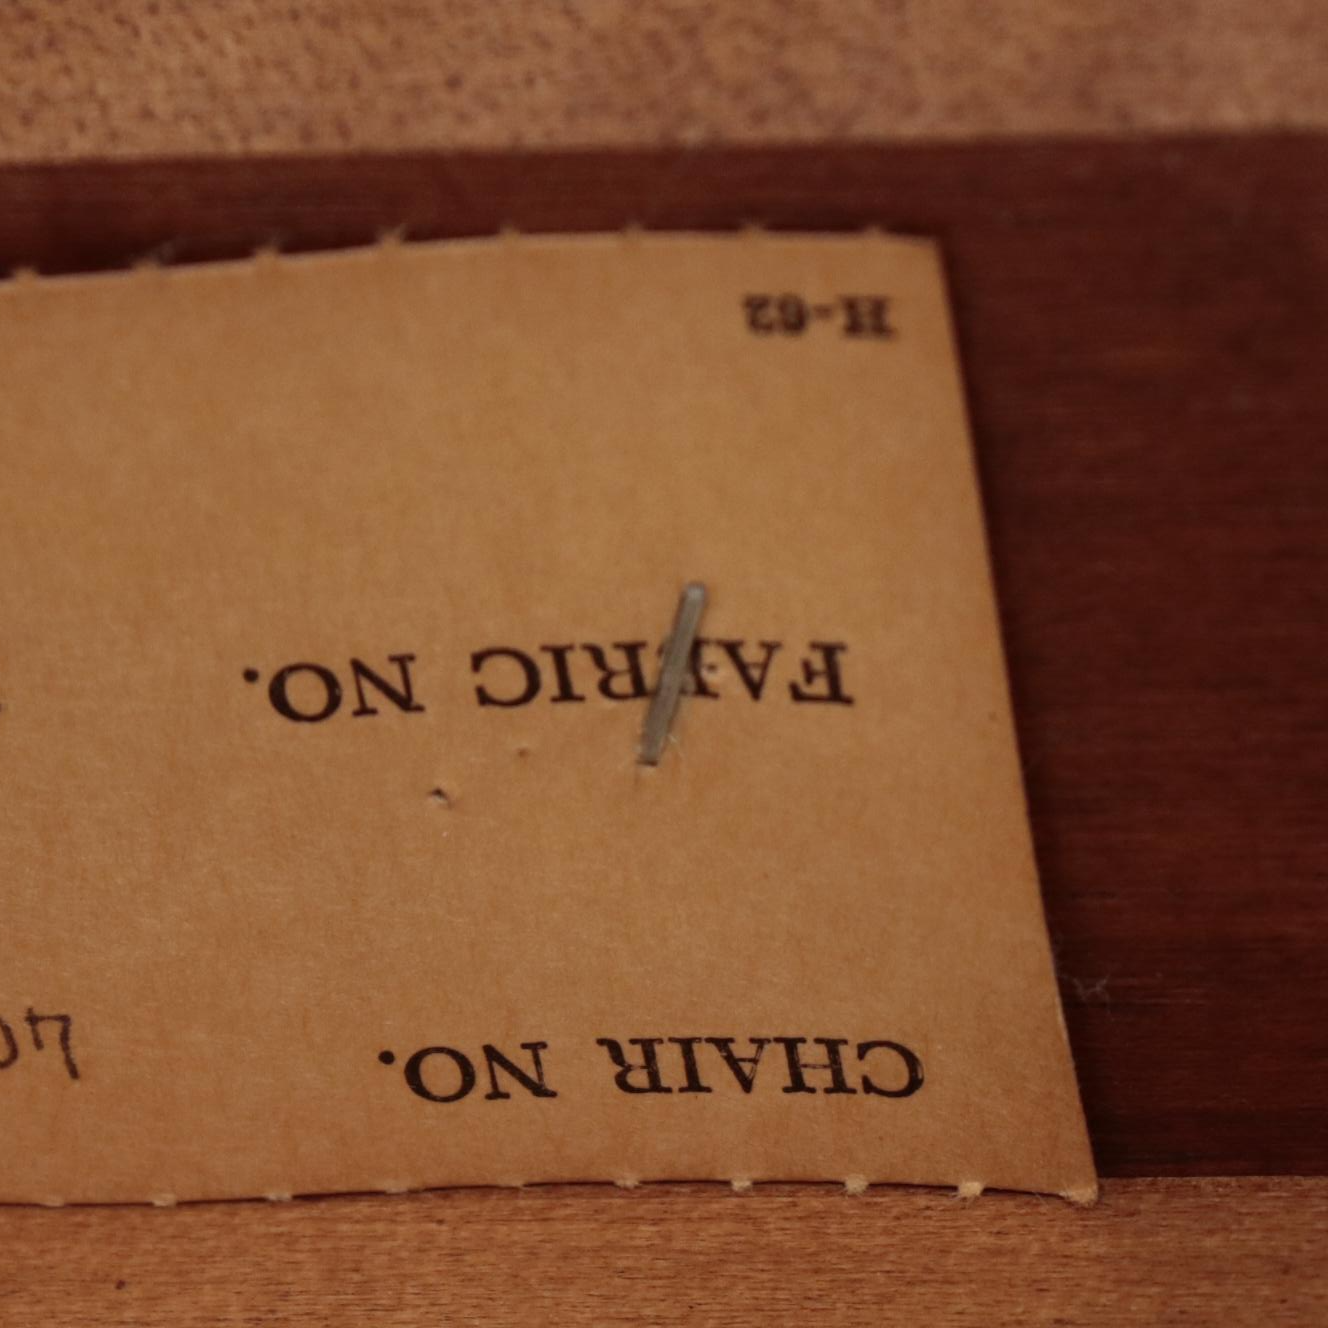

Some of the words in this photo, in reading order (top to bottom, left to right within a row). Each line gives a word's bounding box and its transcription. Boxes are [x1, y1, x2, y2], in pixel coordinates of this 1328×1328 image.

[745, 296, 893, 340] H-62
[244, 655, 424, 722] NO.
[379, 1042, 557, 1103] NO.
[598, 1038, 924, 1098] CHAIR
